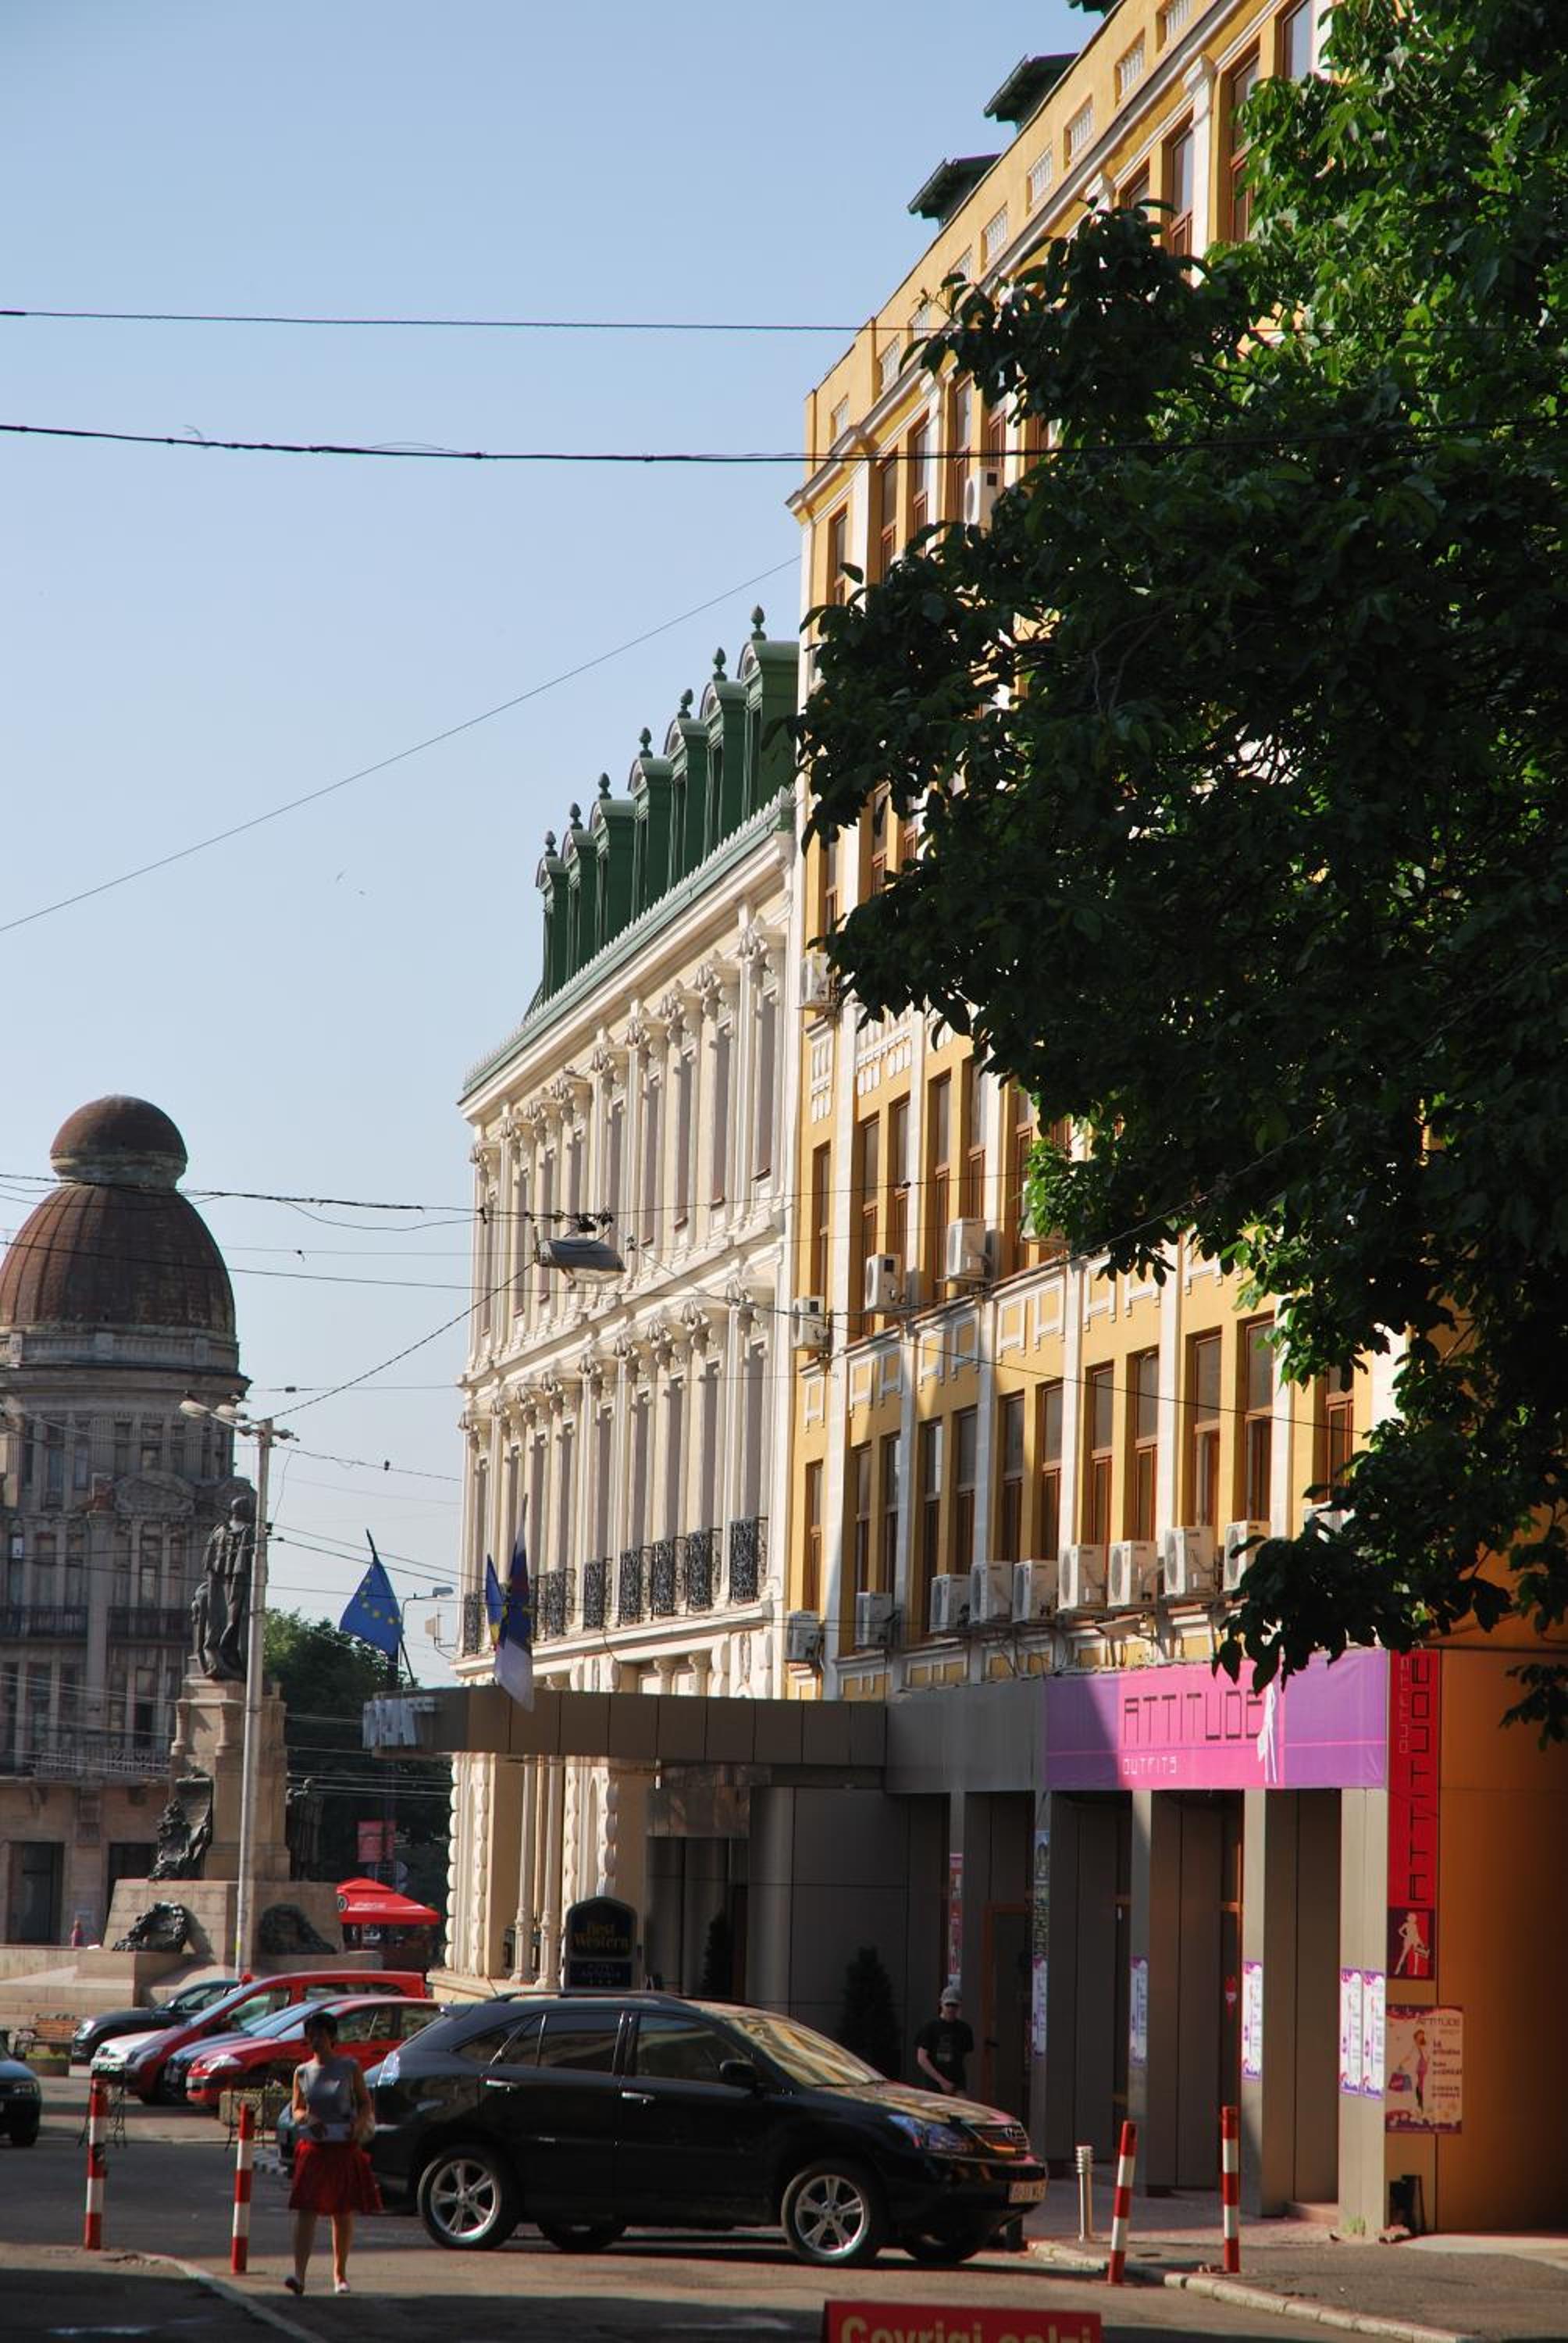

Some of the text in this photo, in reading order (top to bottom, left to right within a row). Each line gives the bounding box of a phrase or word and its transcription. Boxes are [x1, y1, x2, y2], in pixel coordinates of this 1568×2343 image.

[1124, 1690, 1263, 1744] ATTITUDE
[1124, 1756, 1178, 1775] OUTFITS
[1409, 1657, 1430, 1902] ATTITUDE
